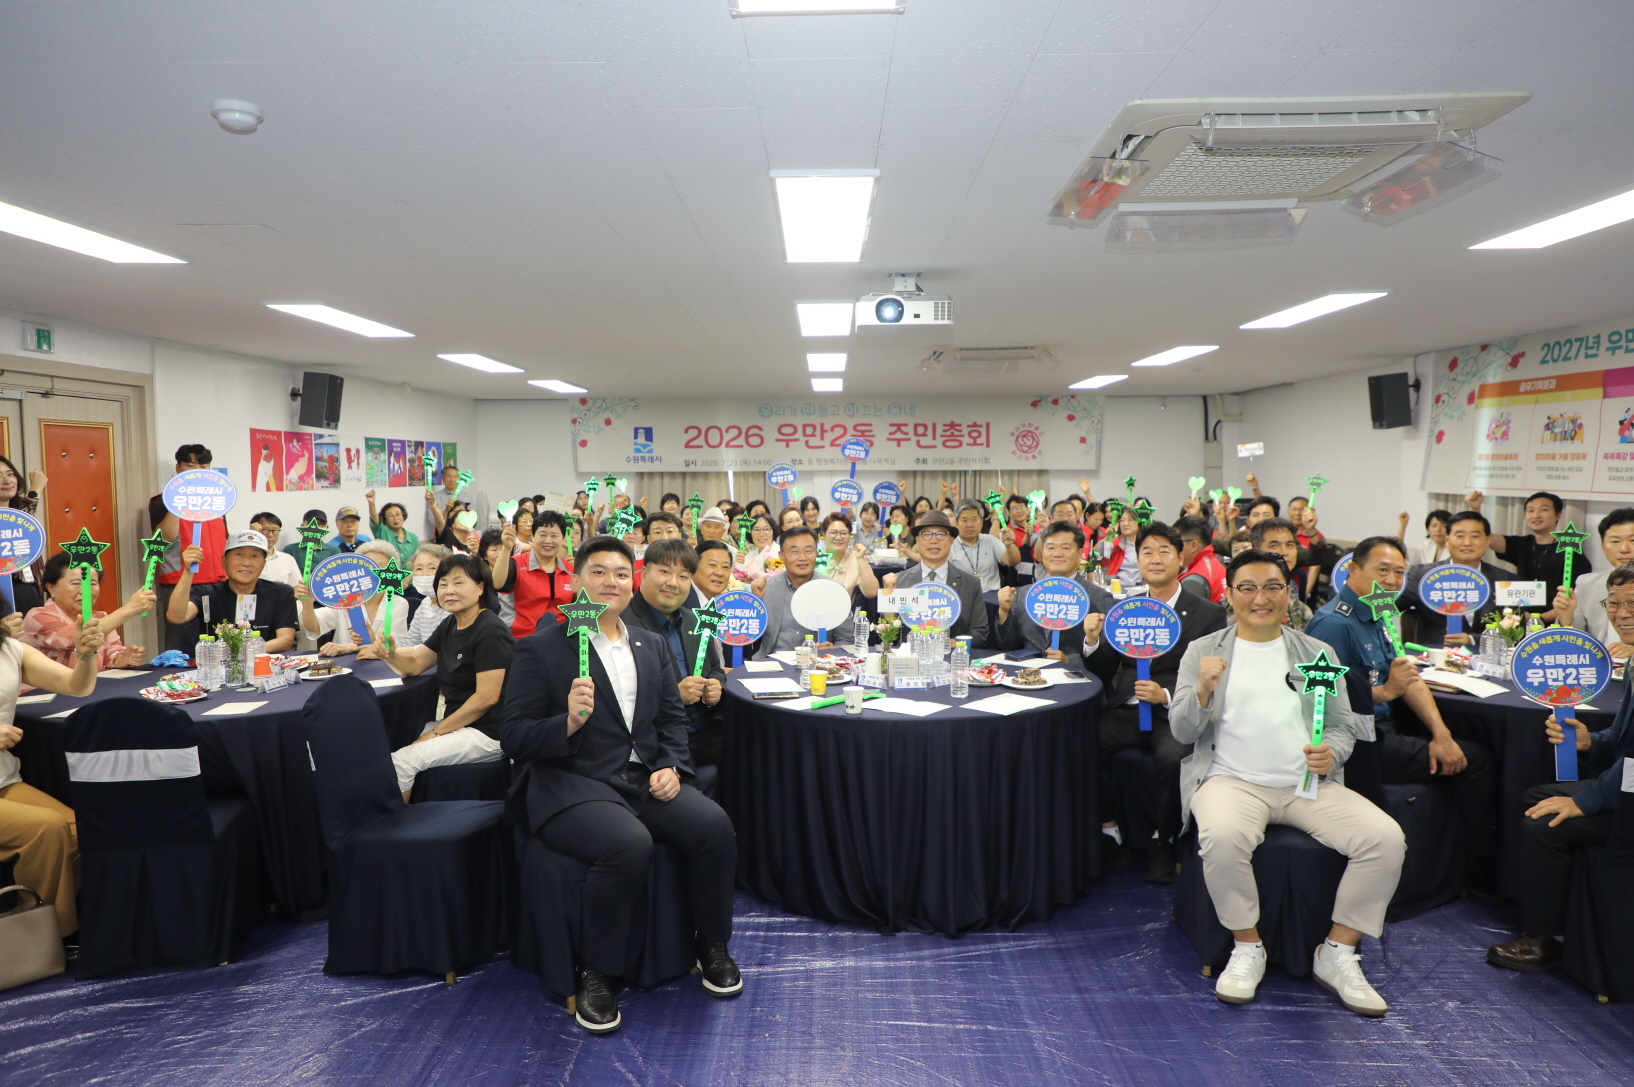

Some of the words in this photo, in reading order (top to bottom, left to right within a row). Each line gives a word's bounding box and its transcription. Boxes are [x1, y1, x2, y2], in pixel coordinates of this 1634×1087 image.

[1540, 334, 1602, 365] 2027년
[758, 403, 798, 418] 우리가
[801, 403, 840, 418] 만들고
[684, 425, 764, 448] 2026
[775, 422, 876, 450] 우만2동
[886, 420, 990, 449] 주민총회
[625, 455, 662, 464] 수원특례시
[684, 459, 697, 467] 일시
[870, 457, 896, 466] 다목적실
[958, 457, 990, 465] 주민자치회
[178, 486, 223, 494] 수원특례시
[172, 496, 226, 511] 우만2동
[17, 517, 36, 532] 빛나게
[0, 528, 23, 539] 례시
[304, 531, 321, 539] 우만2동
[70, 546, 98, 554] 우만2동
[149, 544, 165, 552] 우만2동
[324, 568, 365, 584] 수원특례시
[380, 571, 403, 580] 우만2동
[322, 576, 373, 599] 우만2동
[1038, 593, 1077, 603] 수원특례시
[1429, 590, 1480, 602] 우만2동
[1507, 590, 1536, 598] 유관기관
[888, 596, 896, 605] 내
[900, 596, 907, 605] 빈
[912, 596, 918, 605] 석
[1372, 596, 1393, 606] 우만2동
[1033, 602, 1080, 620] 우만2동
[1123, 601, 1141, 610] 새롭게
[1142, 602, 1160, 611] 시민을
[571, 610, 596, 619] 우만2동
[720, 608, 757, 618] 수원특례시
[701, 615, 718, 625] 우만2동
[1118, 617, 1165, 626] 수원특례시
[718, 618, 760, 634] 우만2동
[1115, 628, 1170, 645] 우만2동
[1521, 642, 1539, 658] 수원을
[1539, 635, 1560, 644] 새롭게
[1562, 635, 1583, 646] 시민을
[1584, 641, 1604, 659] 빛나게
[1532, 654, 1589, 666] 수원특례시
[1308, 670, 1335, 680] 우만2동
[1526, 667, 1597, 686] 우만2동
